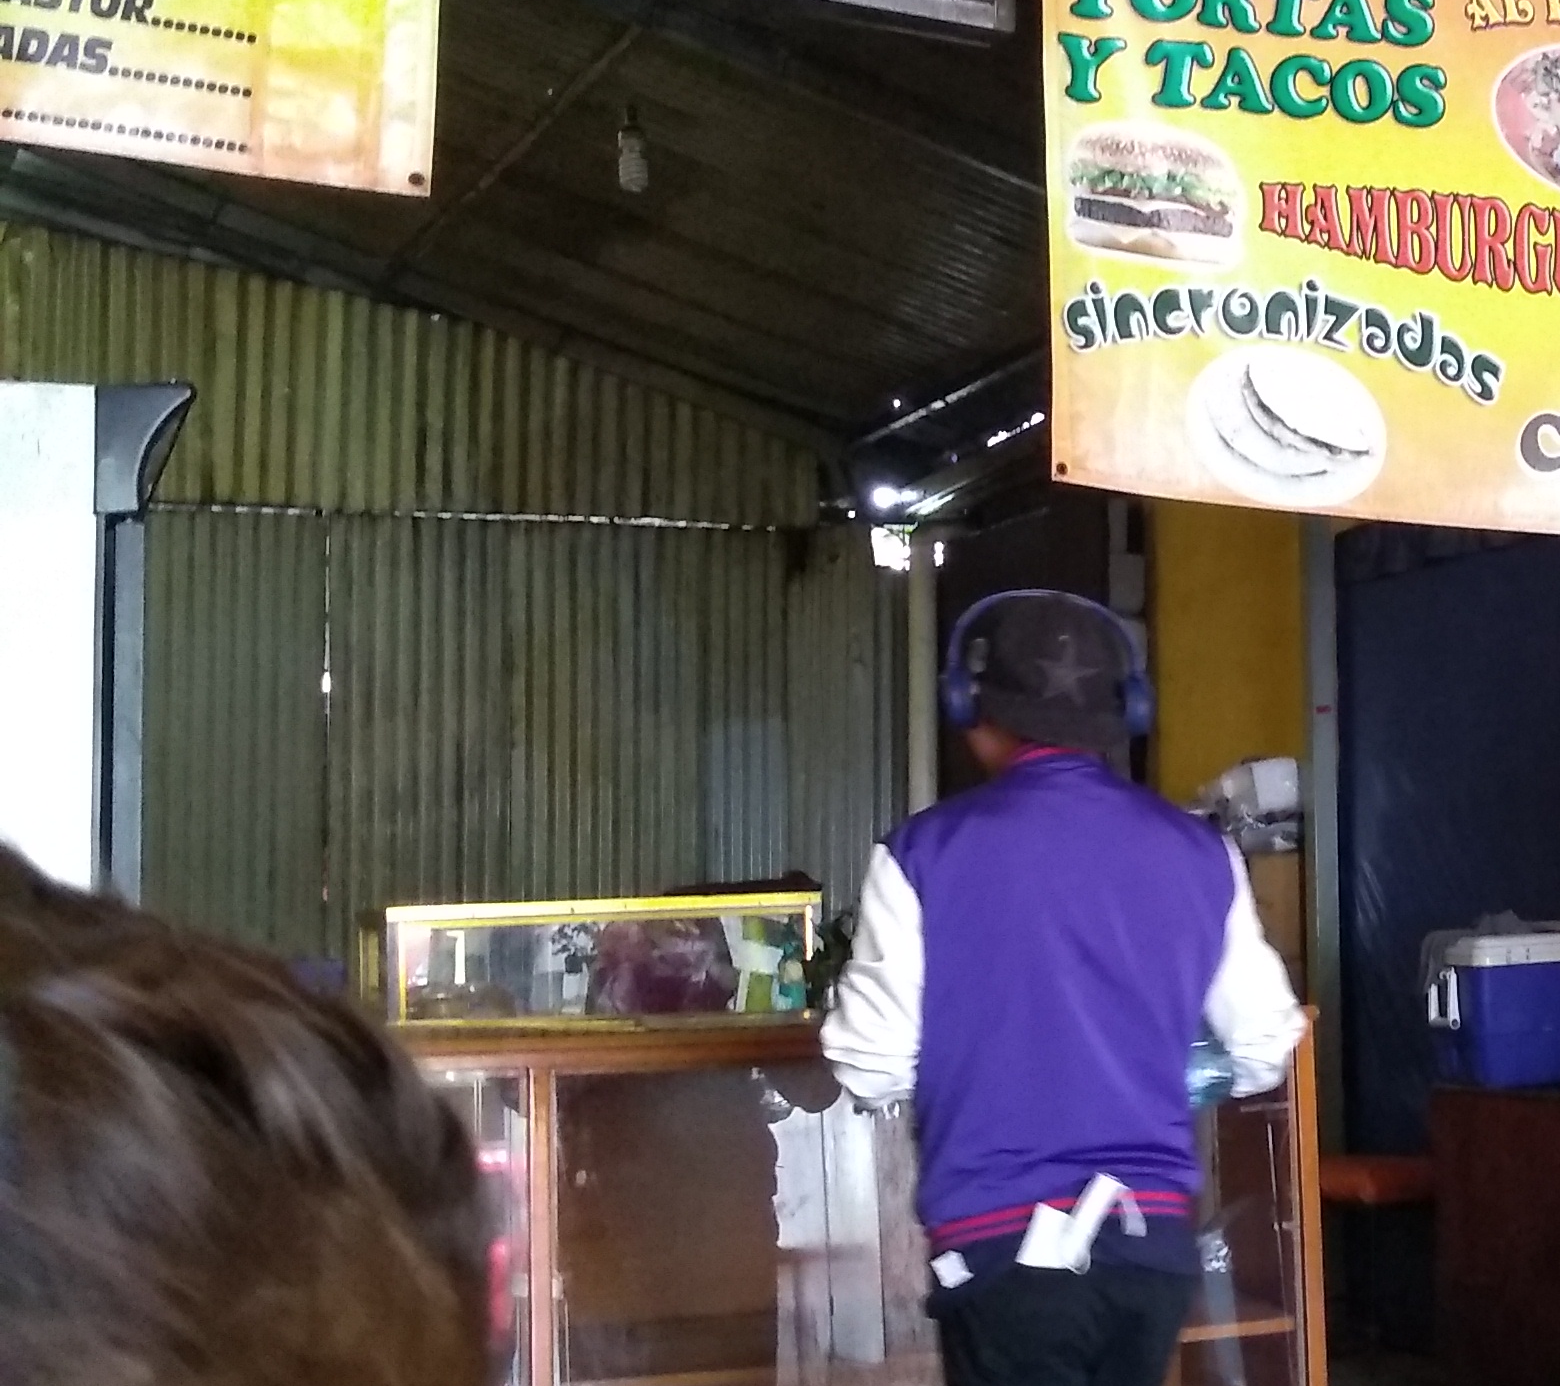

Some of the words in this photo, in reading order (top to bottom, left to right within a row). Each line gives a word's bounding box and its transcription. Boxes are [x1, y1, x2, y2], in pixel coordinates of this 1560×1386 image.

[1057, 32, 1126, 104] Y
[1146, 37, 1447, 127] TACOS
[1063, 280, 1504, 404] sincronizadas
